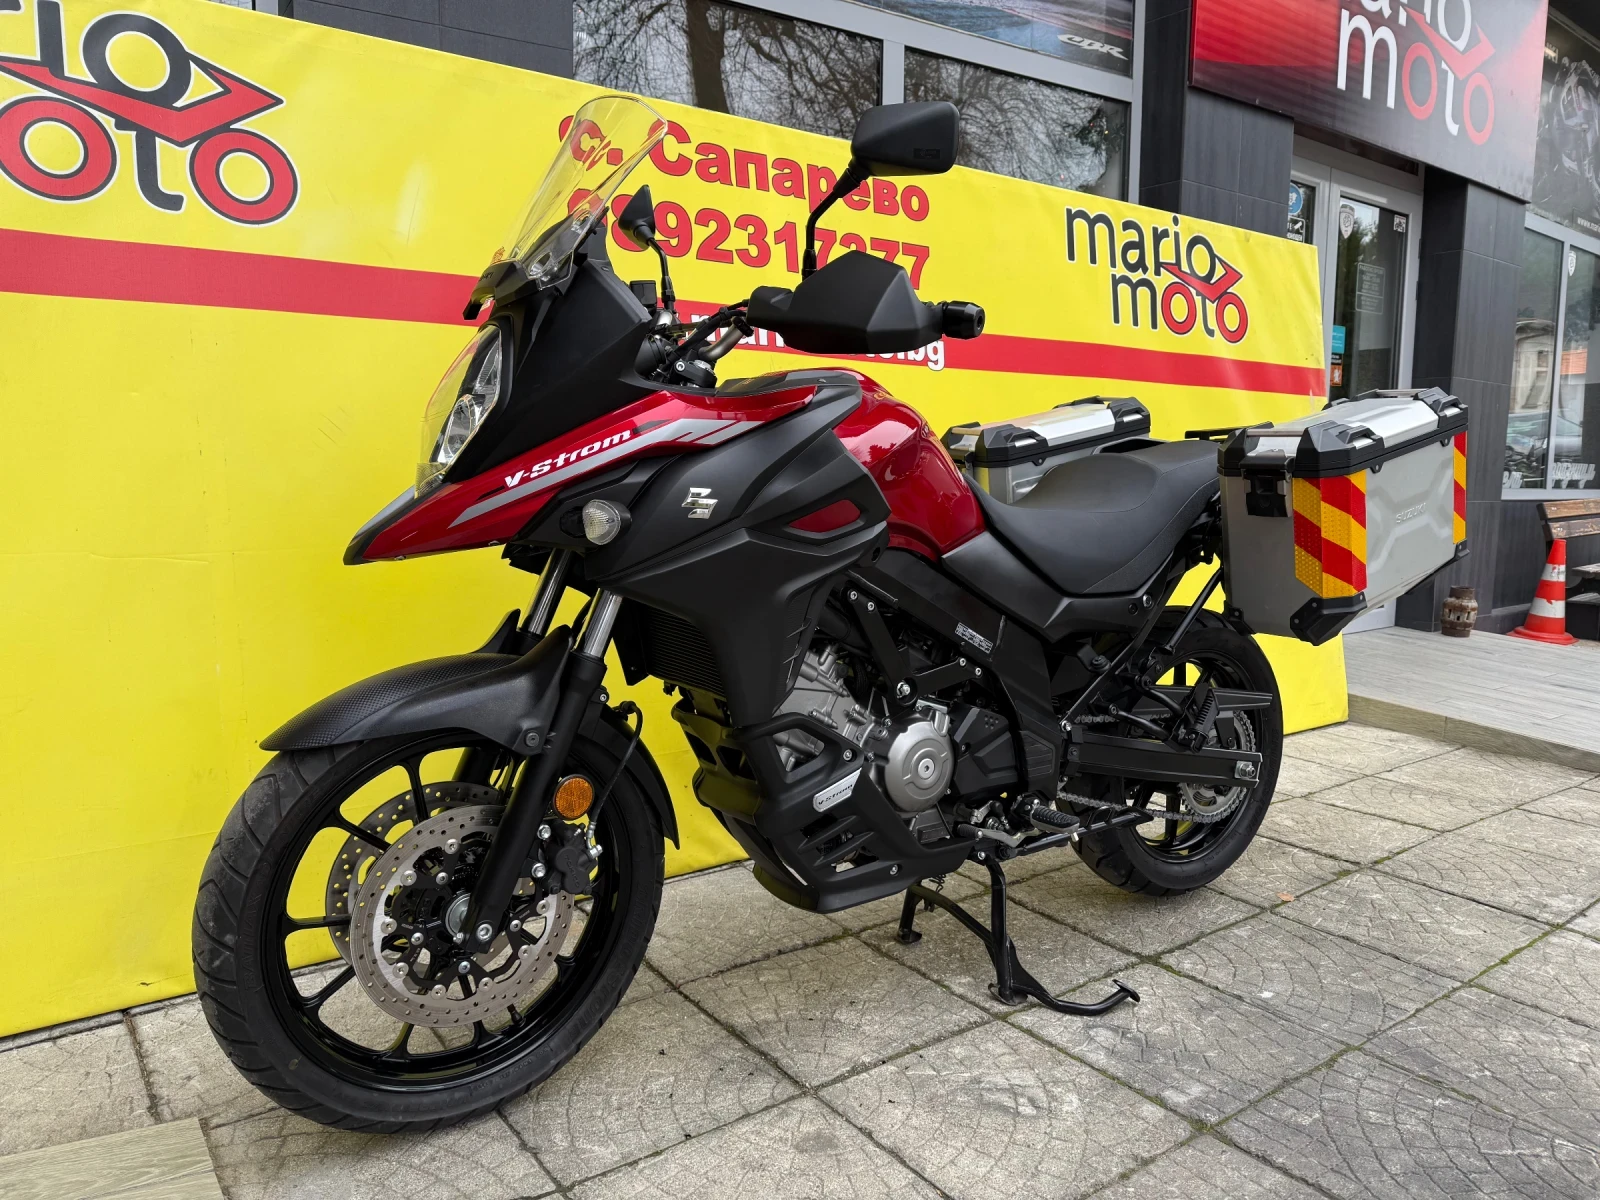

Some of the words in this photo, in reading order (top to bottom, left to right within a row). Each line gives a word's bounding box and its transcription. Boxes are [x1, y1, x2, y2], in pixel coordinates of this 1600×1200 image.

[1337, 8, 1495, 146] moto
[1065, 207, 1217, 284] mario
[1111, 273, 1249, 344] moto
